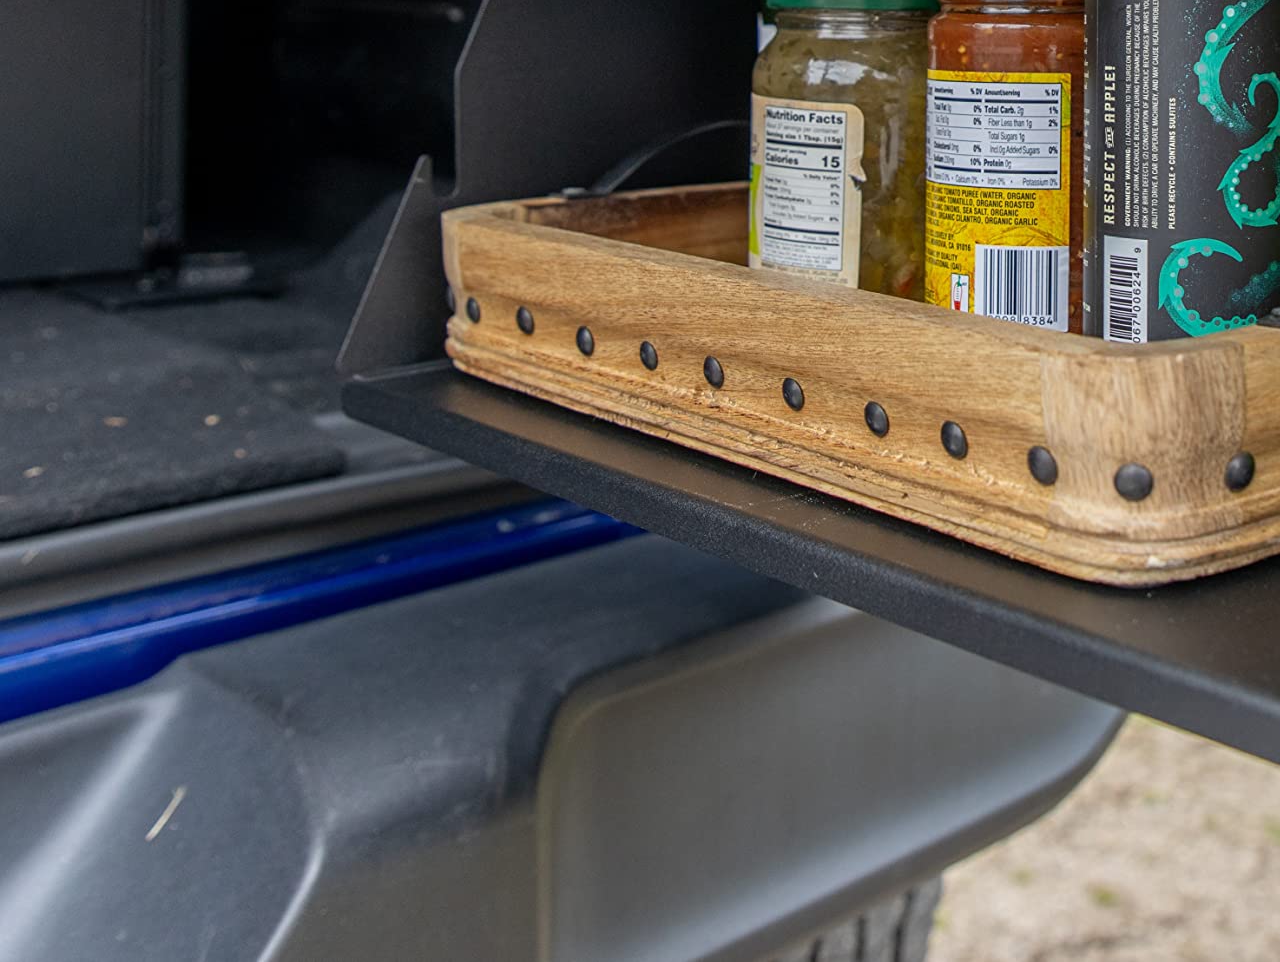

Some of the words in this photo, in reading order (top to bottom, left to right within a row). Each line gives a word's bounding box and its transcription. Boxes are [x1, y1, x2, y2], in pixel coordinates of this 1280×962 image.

[1104, 65, 1116, 123] APPLE!
[973, 105, 982, 113] 0%
[984, 105, 999, 114] Total
[1000, 105, 1016, 114] Carb.
[1143, 101, 1149, 109] OF
[766, 108, 806, 123] Nutrition
[809, 113, 843, 125] Facts
[1168, 97, 1176, 129] SULFITES
[988, 119, 1000, 127] Fiber
[1001, 119, 1012, 127] Less
[1013, 119, 1025, 127] than
[988, 131, 999, 139] Total
[1000, 132, 1018, 142] Sugars
[1006, 144, 1022, 153] Added
[1023, 145, 1040, 155] Sugars
[1168, 131, 1176, 165] CONTAINS
[766, 153, 799, 165] Calories
[821, 155, 840, 168] 15
[970, 158, 981, 166] 10%
[1152, 153, 1159, 162] OR
[983, 159, 1004, 167] Protein
[1023, 178, 1049, 186] Potassium
[1168, 172, 1176, 202] RECYCLE
[1103, 150, 1116, 225] RESPECT
[962, 190, 978, 198] PUREE
[1007, 192, 1036, 200] ORGANIC
[976, 200, 1002, 208] ORGANIC
[1005, 201, 1034, 209] ROASTED
[1152, 198, 1159, 206] TO
[991, 208, 1019, 216] ORGANIC
[1168, 204, 1176, 230] PLEASE
[985, 216, 1012, 225] ORGANIC
[1014, 218, 1038, 226] GARLIC
[1133, 272, 1141, 312] 00624
[1023, 316, 1053, 326] 8384
